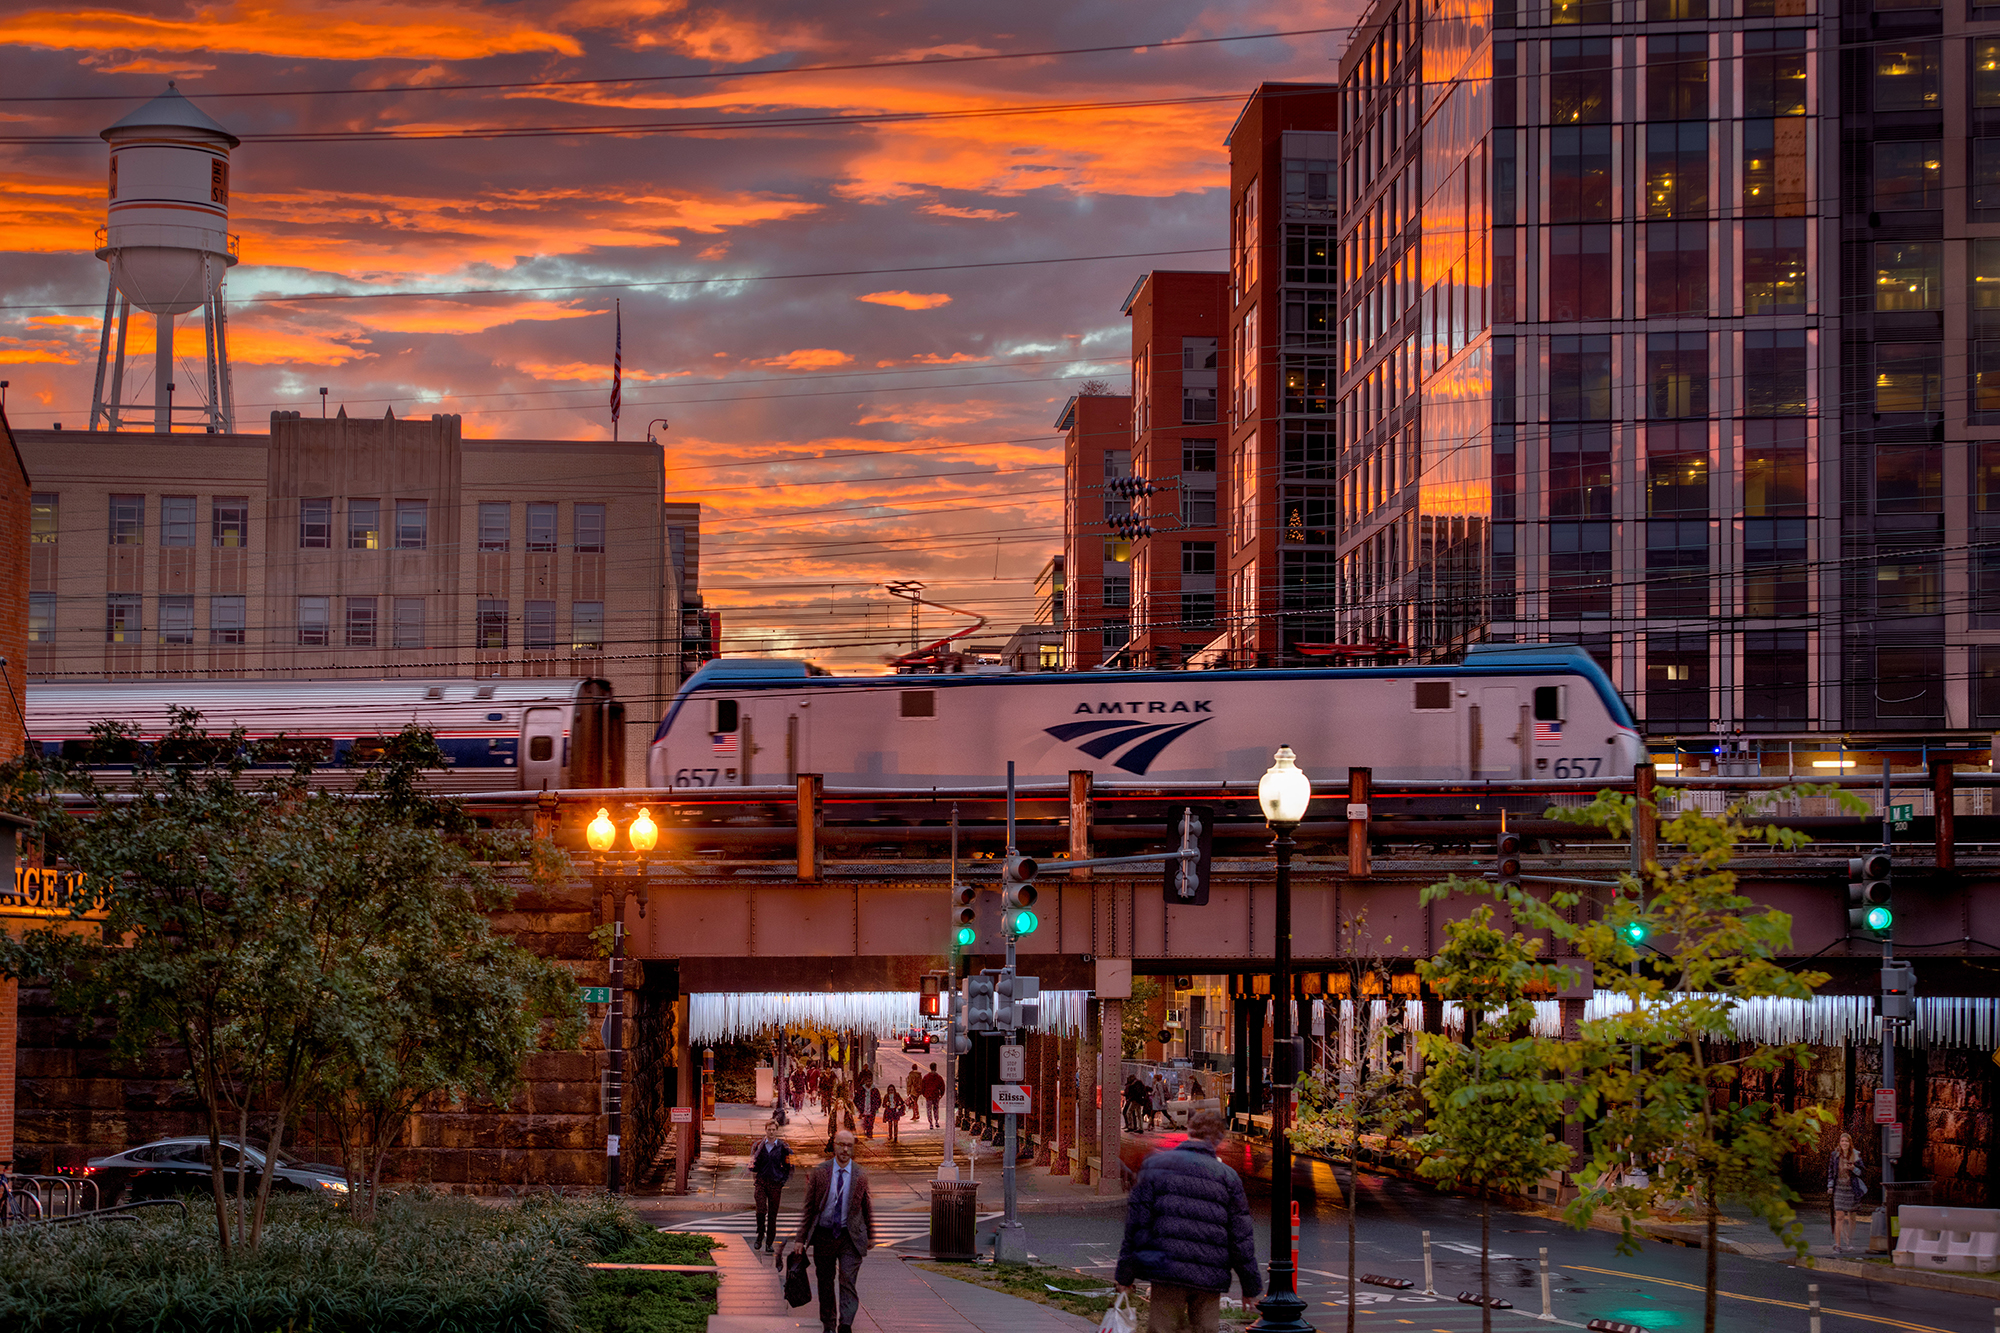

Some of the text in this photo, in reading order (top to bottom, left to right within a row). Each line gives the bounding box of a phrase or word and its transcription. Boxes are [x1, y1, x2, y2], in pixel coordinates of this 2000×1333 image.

[1073, 700, 1213, 714] AMTRAK
[1553, 757, 1603, 779] 657
[675, 768, 720, 787] 657
[1893, 807, 1900, 820] M
[1894, 821, 1908, 831] 200
[583, 989, 592, 1001] 2
[998, 1093, 1025, 1101] Elissa
